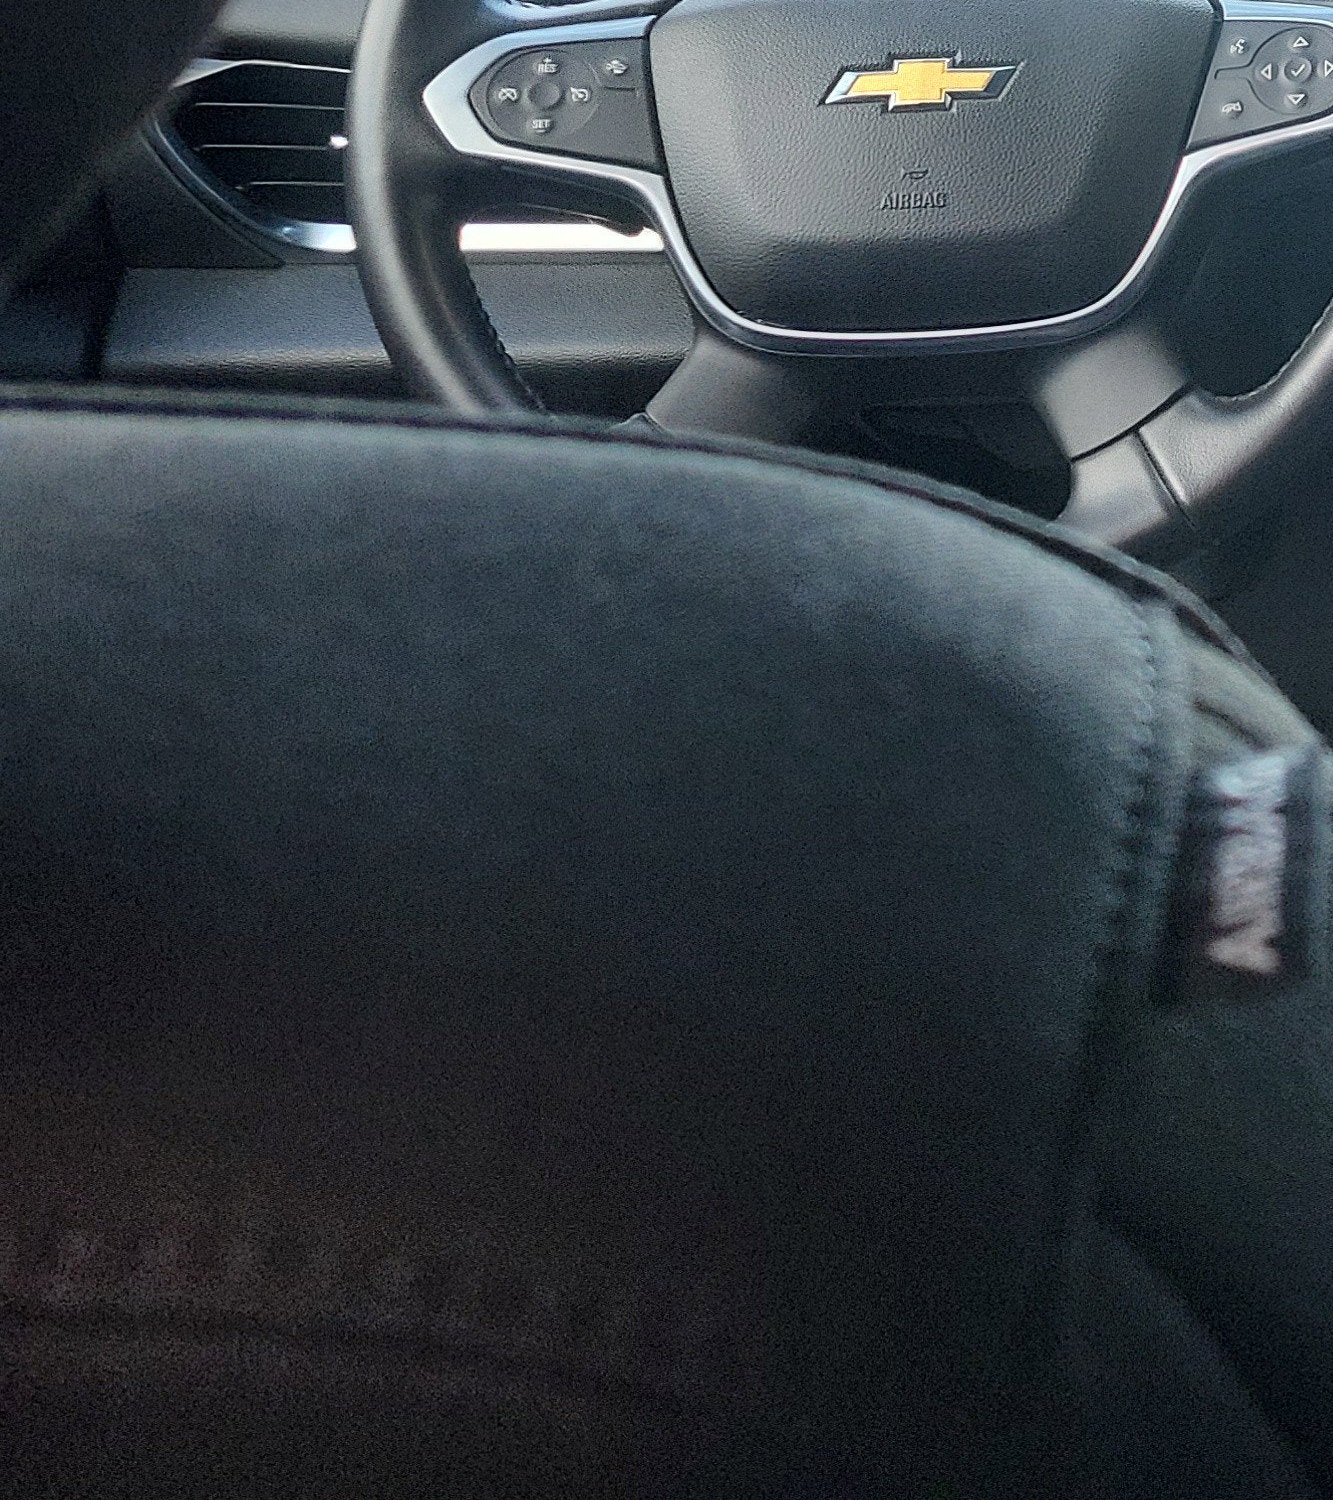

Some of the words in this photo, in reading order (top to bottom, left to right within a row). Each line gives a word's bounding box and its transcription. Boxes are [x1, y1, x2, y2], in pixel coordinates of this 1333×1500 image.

[537, 63, 557, 73] RES
[530, 119, 551, 129] SET
[880, 191, 947, 211] AIRBAG
